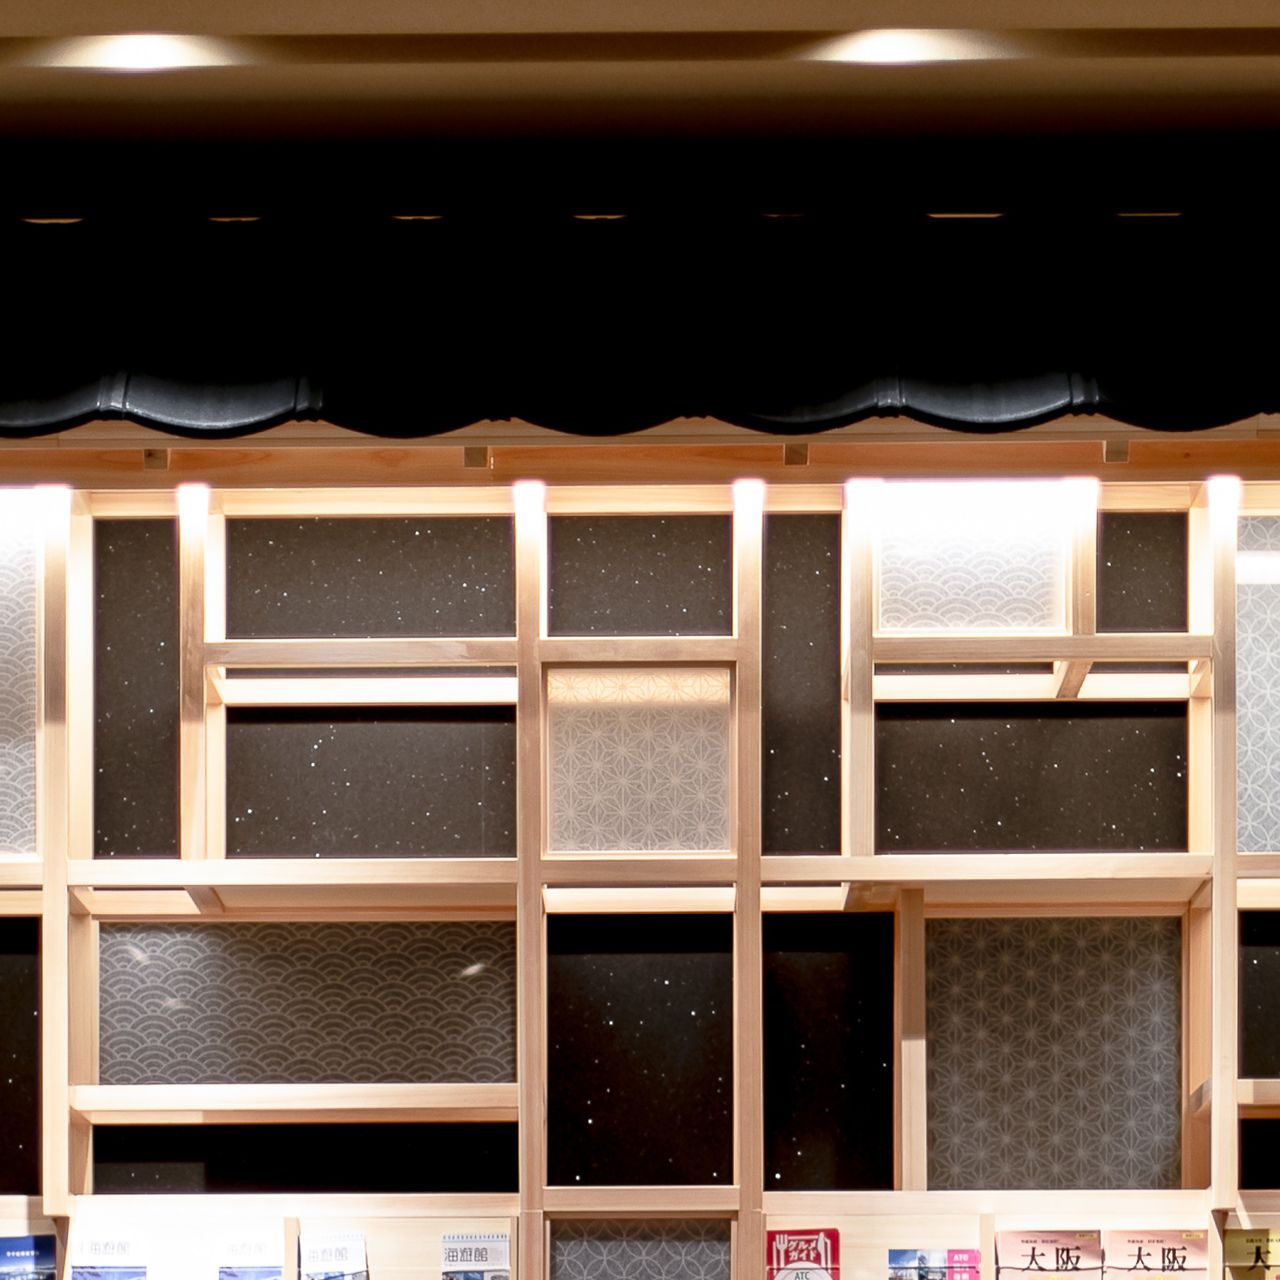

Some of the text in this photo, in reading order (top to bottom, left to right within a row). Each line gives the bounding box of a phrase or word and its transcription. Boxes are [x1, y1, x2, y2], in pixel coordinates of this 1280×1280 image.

[788, 1240, 818, 1250] グルメ
[444, 1247, 488, 1262] 海遊館
[789, 1250, 817, 1261] ガイド
[1021, 1246, 1083, 1272] 大阪
[1127, 1246, 1189, 1272] 大阪
[794, 1271, 810, 1280] ATC
